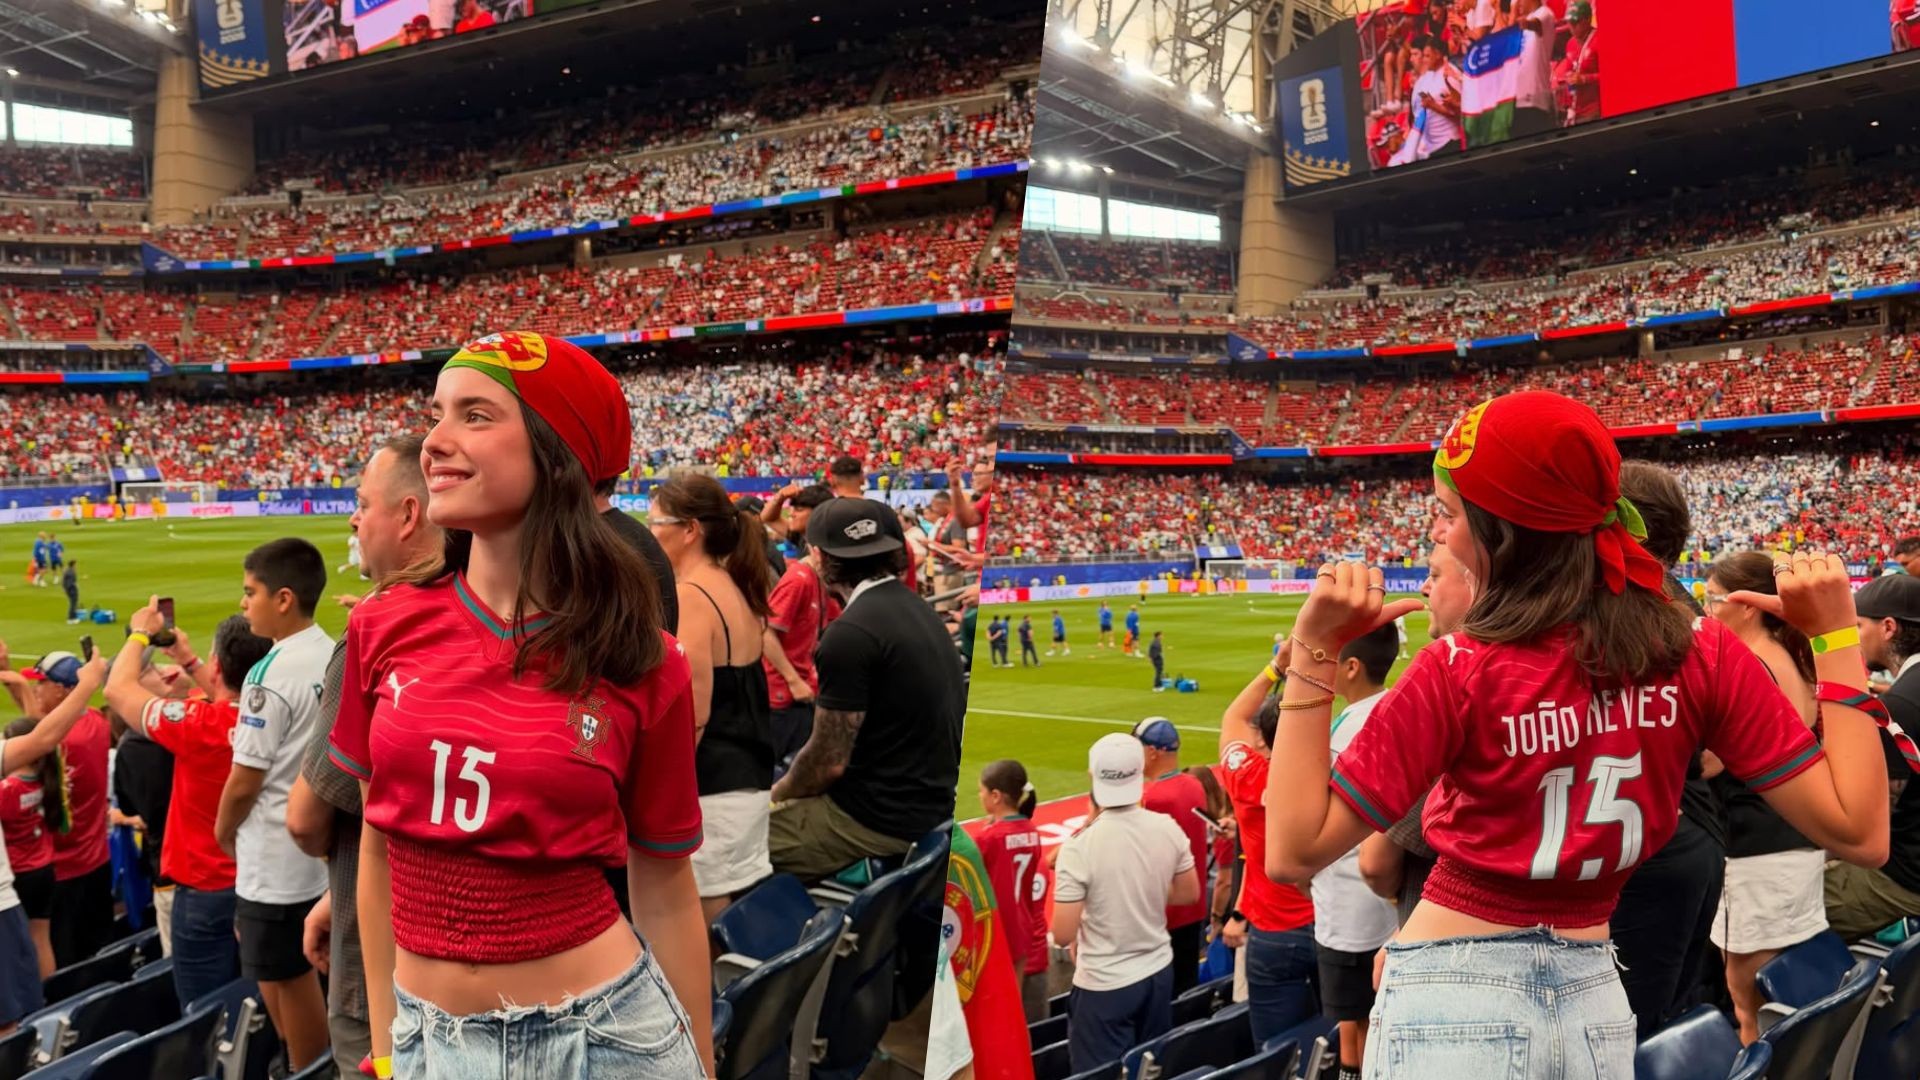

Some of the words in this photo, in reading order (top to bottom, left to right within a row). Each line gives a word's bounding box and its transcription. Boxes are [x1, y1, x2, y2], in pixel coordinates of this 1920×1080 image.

[313, 501, 355, 514] ULTRA
[1501, 700, 1580, 757] JOÃO
[1586, 685, 1678, 736] NEVES
[429, 739, 497, 832] 15
[1530, 749, 1643, 881] 15
[1013, 852, 1033, 904] 7
